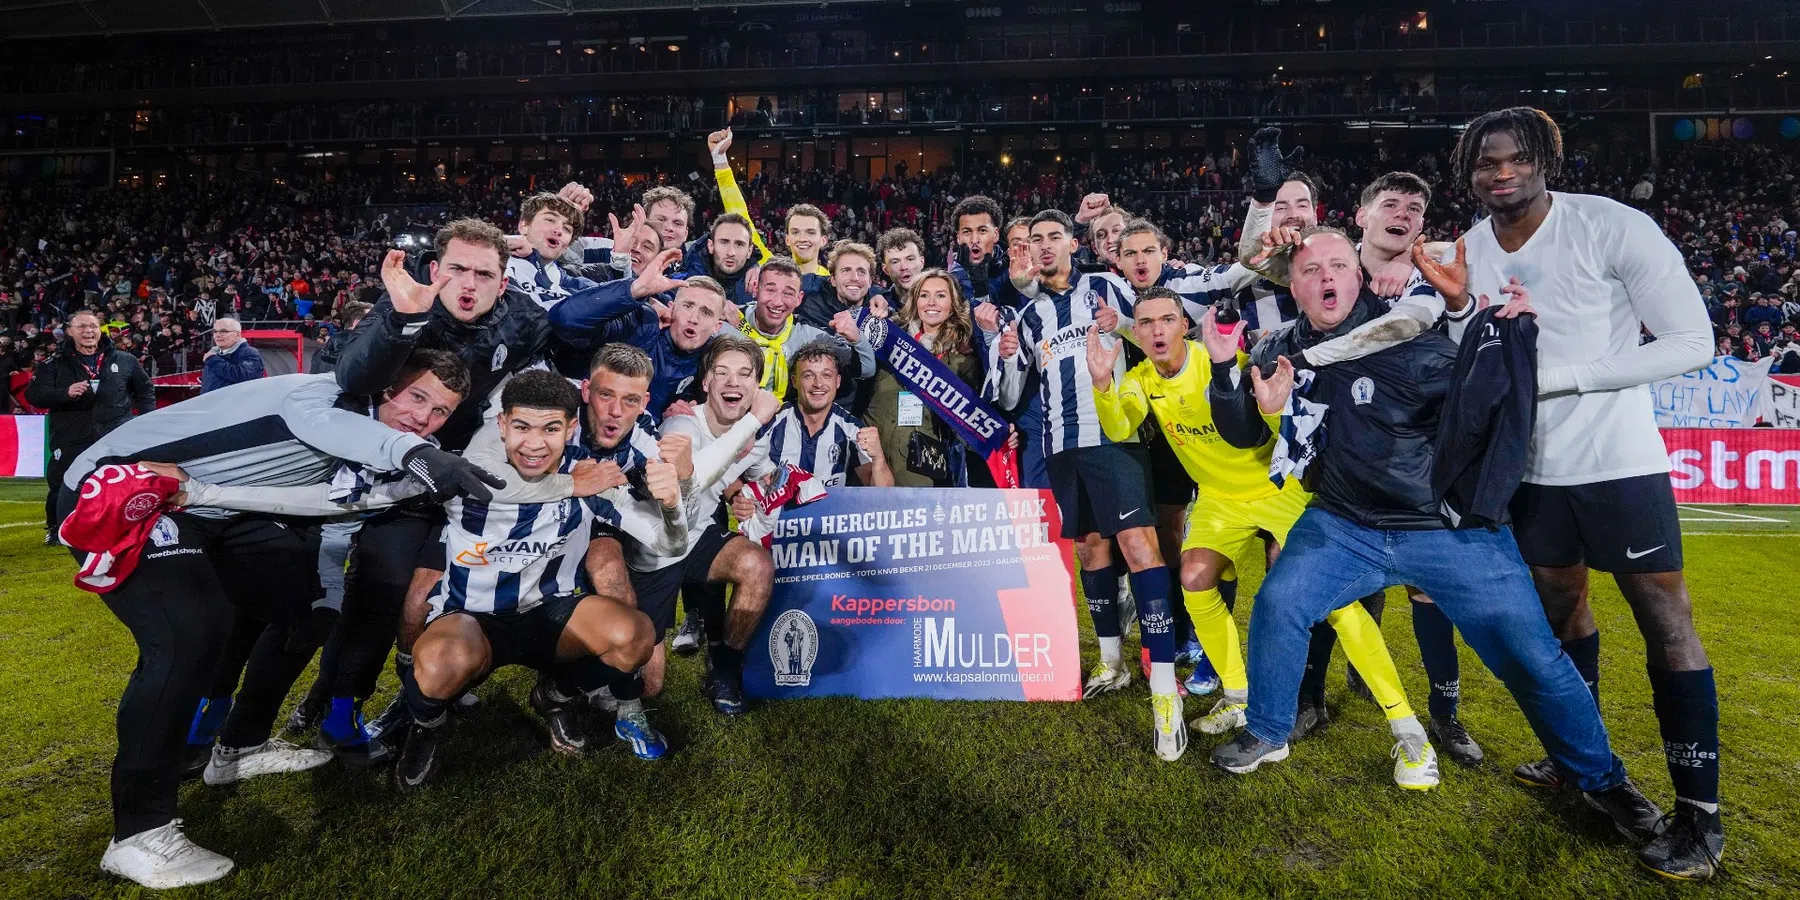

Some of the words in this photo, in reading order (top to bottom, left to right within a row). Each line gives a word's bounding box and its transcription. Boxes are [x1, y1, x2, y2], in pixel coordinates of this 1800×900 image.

[896, 336, 917, 353] USV
[888, 344, 1003, 439] HERCULES
[773, 516, 813, 539] USV
[821, 507, 927, 535] HERCULES
[949, 502, 987, 524] AFC
[994, 498, 1047, 520] AJAX
[771, 539, 840, 570] MAN
[847, 535, 881, 563] OF
[888, 530, 944, 561] THE
[951, 521, 1050, 555] MATCH
[801, 571, 851, 582] SPEELRONDE
[857, 569, 877, 578] TOTO
[877, 567, 898, 575] KNVB
[900, 565, 925, 573] BEKER
[932, 561, 972, 571] DECEMBER
[973, 559, 991, 567] 2023
[831, 594, 955, 615] Kappersbon
[830, 616, 883, 626] aangeboden
[883, 616, 906, 625] door:
[1145, 612, 1164, 621] USV
[1147, 626, 1169, 634] 1882
[913, 617, 922, 668] HAARMODE
[924, 617, 1053, 668] MULDER
[913, 670, 1054, 685] www.kapsalonmulder.nl
